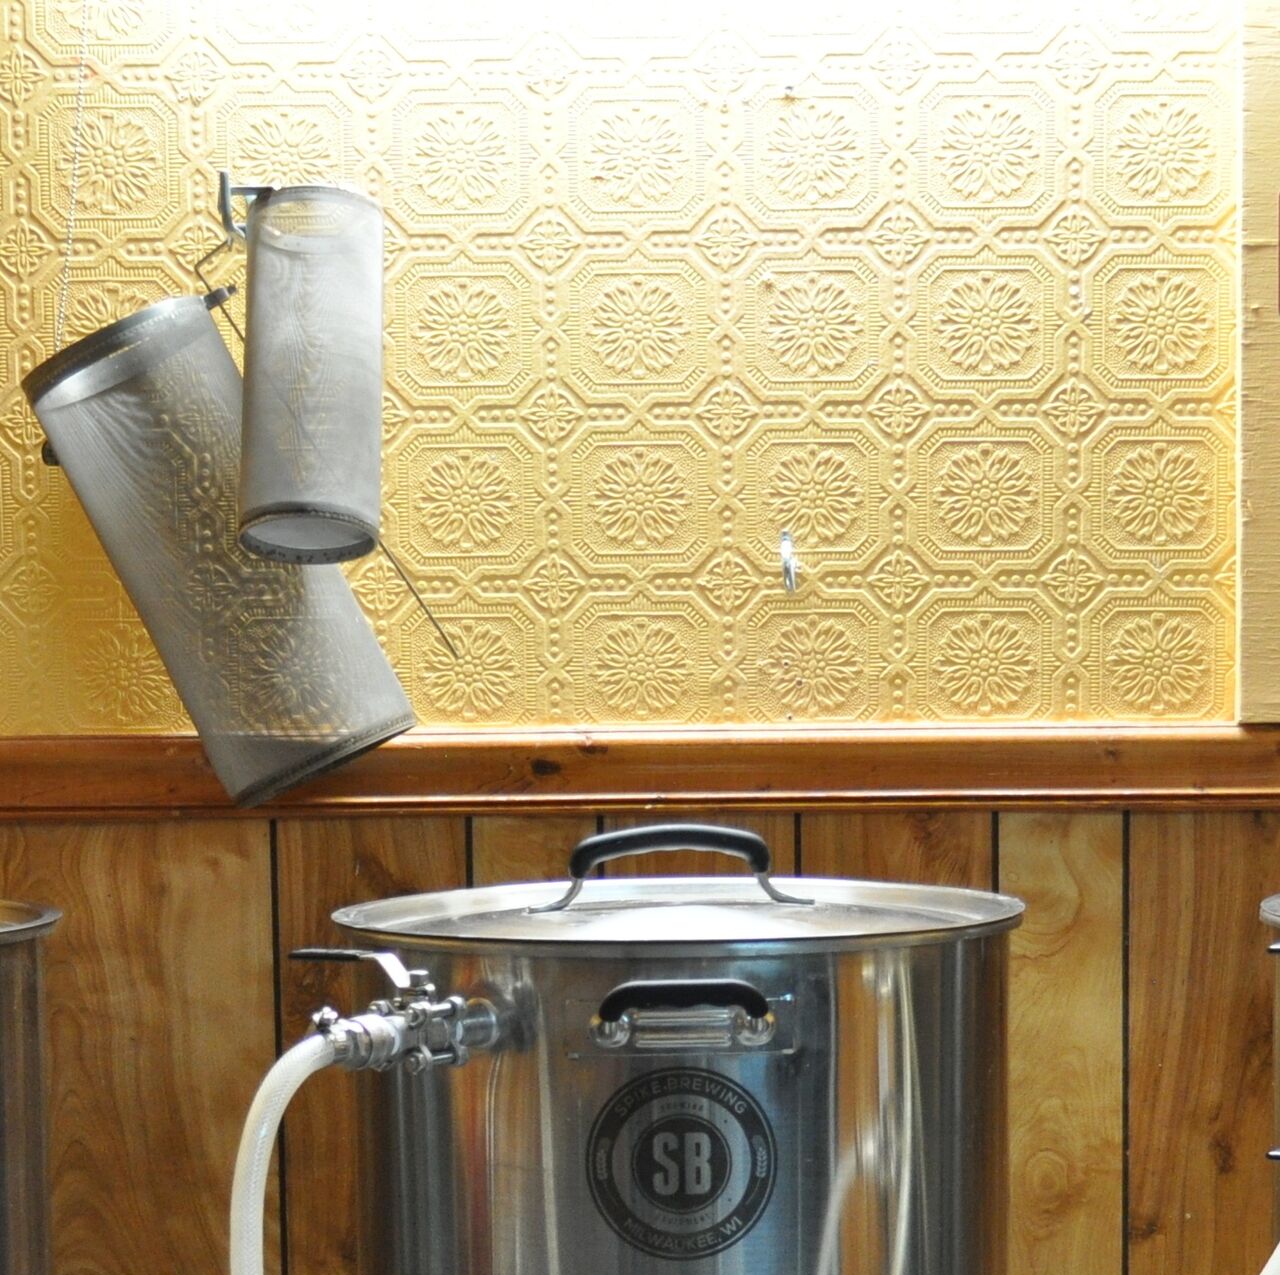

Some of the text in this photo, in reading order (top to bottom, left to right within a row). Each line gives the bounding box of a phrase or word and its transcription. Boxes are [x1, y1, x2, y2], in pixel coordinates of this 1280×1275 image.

[615, 1077, 748, 1117] SPIKE BREWING
[652, 1132, 712, 1196] SB
[721, 1216, 743, 1236] WI
